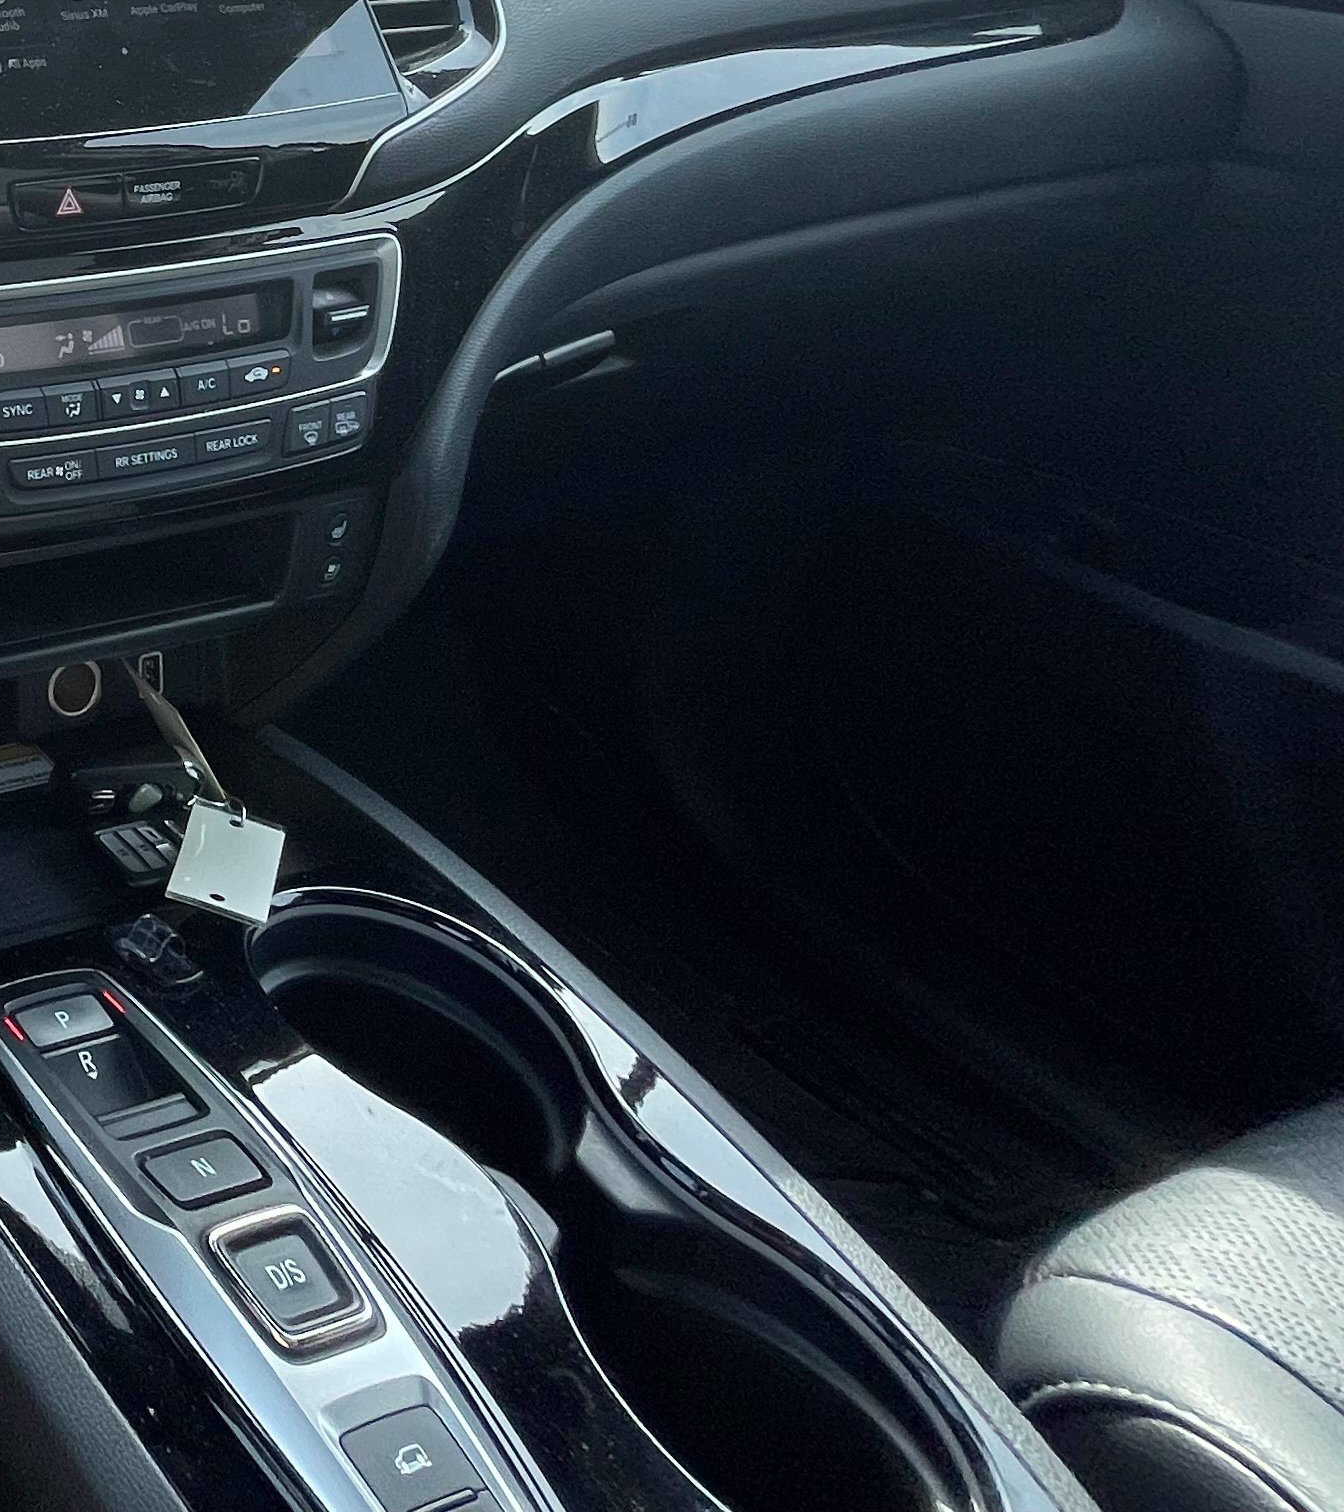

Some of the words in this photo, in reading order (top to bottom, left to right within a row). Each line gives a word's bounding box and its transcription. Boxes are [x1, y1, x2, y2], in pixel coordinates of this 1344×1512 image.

[60, 10, 90, 21] Sirius
[90, 8, 109, 19] XM
[130, 5, 159, 17] Apple
[160, 1, 198, 13] CarPlay
[22, 56, 48, 70] Apps
[133, 180, 181, 193] PASSENGER
[140, 192, 173, 204] AIRBAG
[222, 312, 251, 336] Lo
[197, 377, 217, 391] A/C
[61, 393, 84, 403] MODE
[2, 403, 34, 419] SYNC
[336, 411, 356, 421] REAR
[298, 420, 324, 432] FRONT
[205, 438, 232, 453] REAR
[233, 434, 259, 448] LOCK
[115, 455, 130, 469] RR
[130, 447, 179, 467] SETTINGS
[26, 468, 55, 482] REAR
[65, 470, 83, 482] OFF
[54, 1011, 70, 1029] P
[78, 1050, 94, 1072] R
[190, 1157, 217, 1178] N
[264, 1257, 307, 1291] D/S
